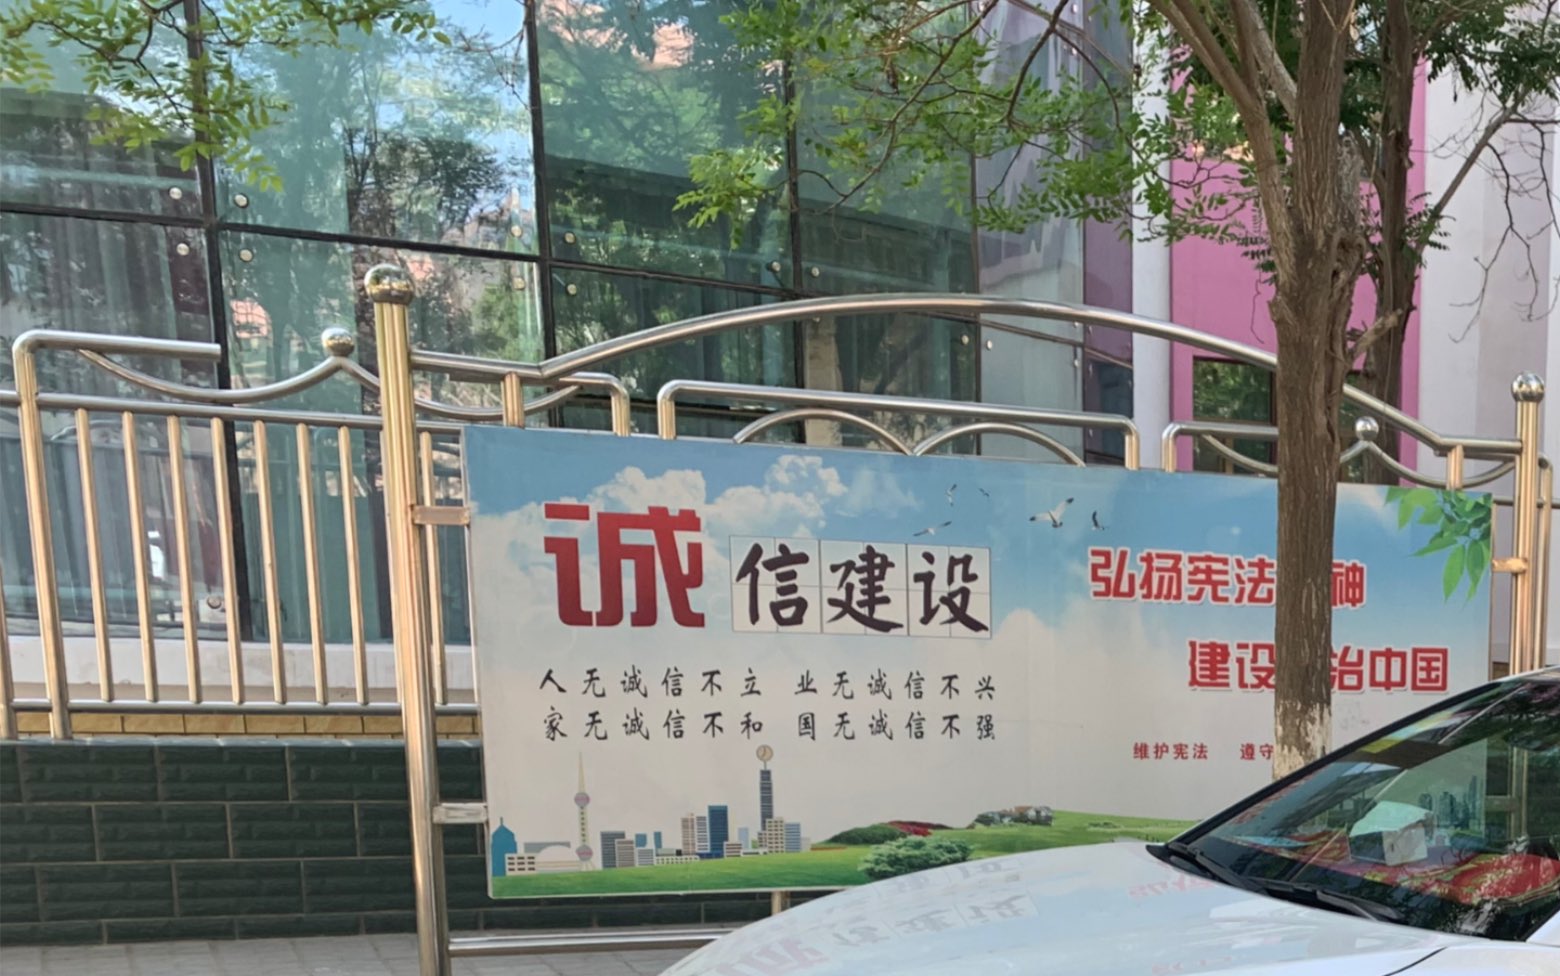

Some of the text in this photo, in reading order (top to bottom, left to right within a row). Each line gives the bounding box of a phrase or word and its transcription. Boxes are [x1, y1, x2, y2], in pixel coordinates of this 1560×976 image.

[544, 503, 990, 633] 诚信建设
[1089, 548, 1366, 608] 弘扬宪法神
[539, 665, 996, 701] 人无诚信不立 业无诚信不兴
[1188, 640, 1449, 694] 建设治中国
[543, 706, 996, 743] 家无诚信不和 国无诚信不强
[1133, 742, 1208, 760] 维护宪法
